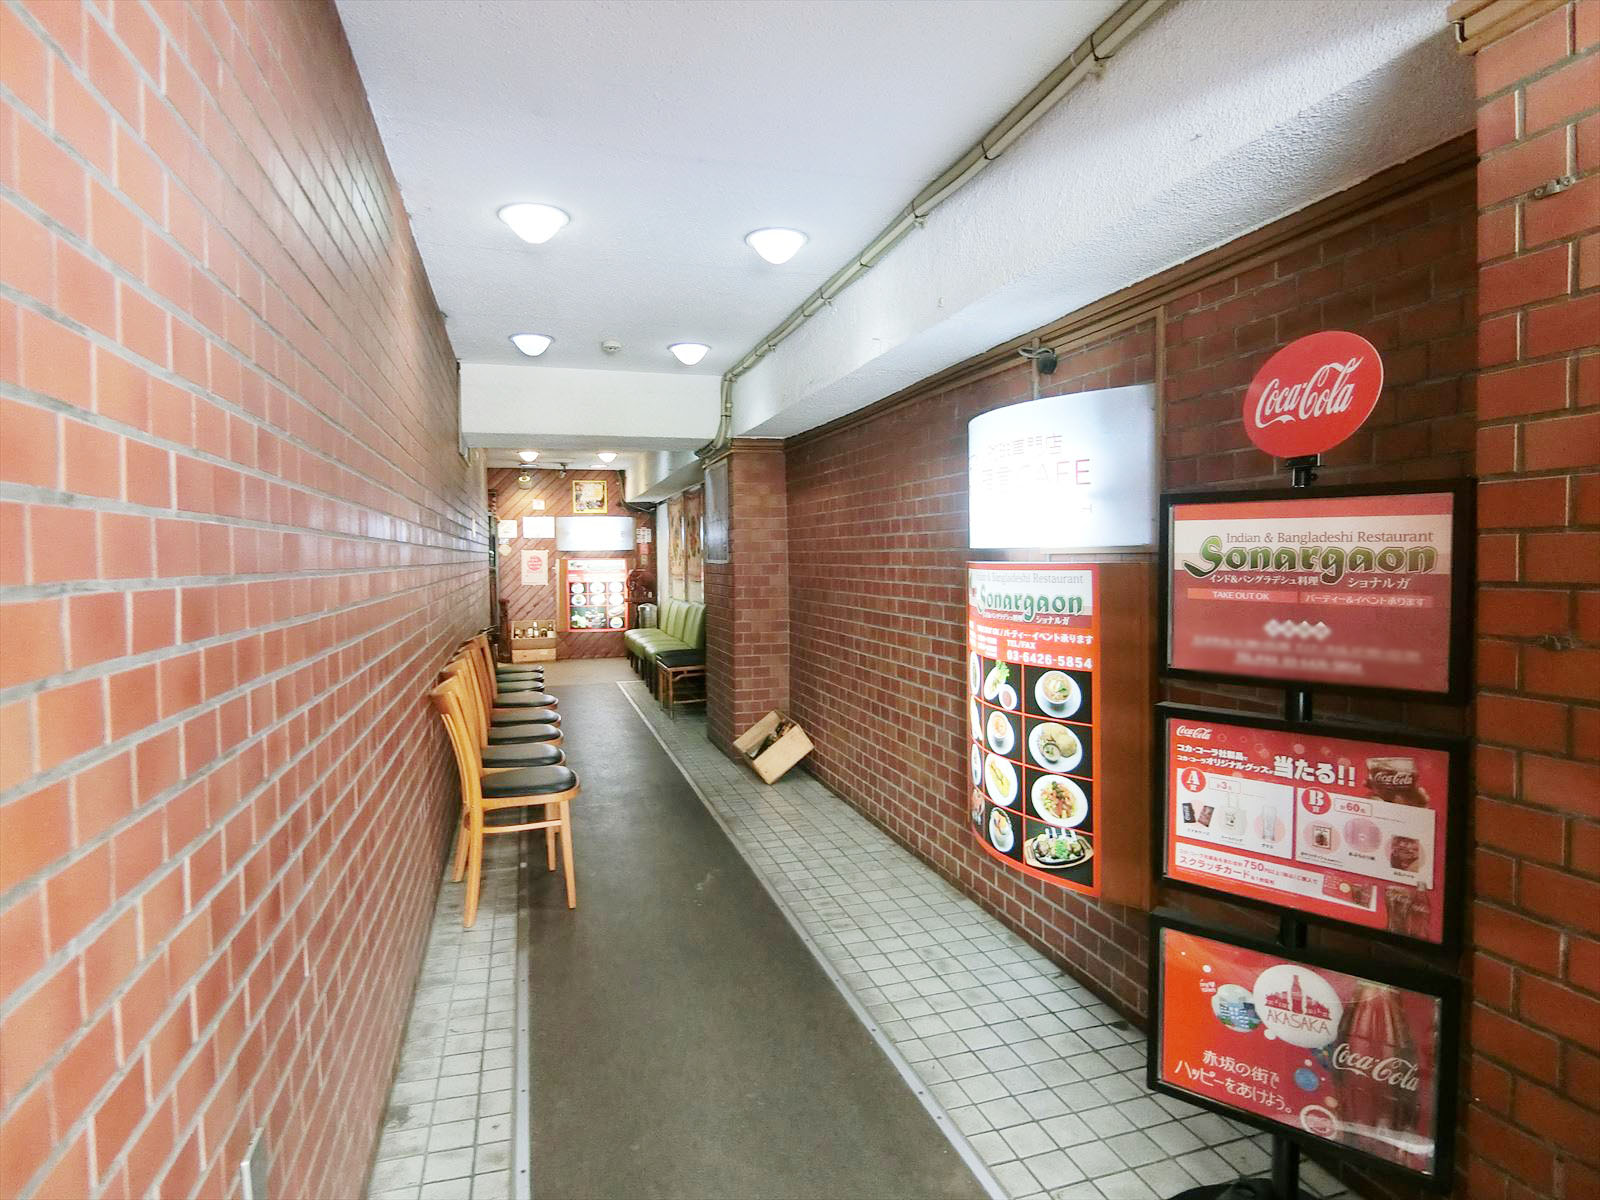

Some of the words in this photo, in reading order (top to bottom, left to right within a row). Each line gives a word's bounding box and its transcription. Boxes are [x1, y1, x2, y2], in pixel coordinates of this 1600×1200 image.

[1255, 356, 1364, 429] Coca-Cola
[1226, 533, 1261, 544] Indian
[1264, 532, 1274, 543] &
[1277, 531, 1353, 545] Bangladeshi
[1357, 531, 1433, 543] Restaurant
[1183, 536, 1438, 585] Sonargaon
[1033, 573, 1084, 584] Restaurant
[1347, 577, 1411, 589] ショナルガ
[977, 584, 1083, 622] Sonargaon
[1212, 591, 1233, 600] TAKE
[1235, 591, 1255, 600] OUT
[1256, 592, 1270, 600] OK
[1006, 649, 1094, 669] 03-6426-5854
[1176, 725, 1212, 740] Coca-Cola
[1267, 1009, 1331, 1035] AKASAKA
[1203, 1050, 1280, 1089] 赤坂の街で
[1332, 1043, 1419, 1091] Coca-Cola
